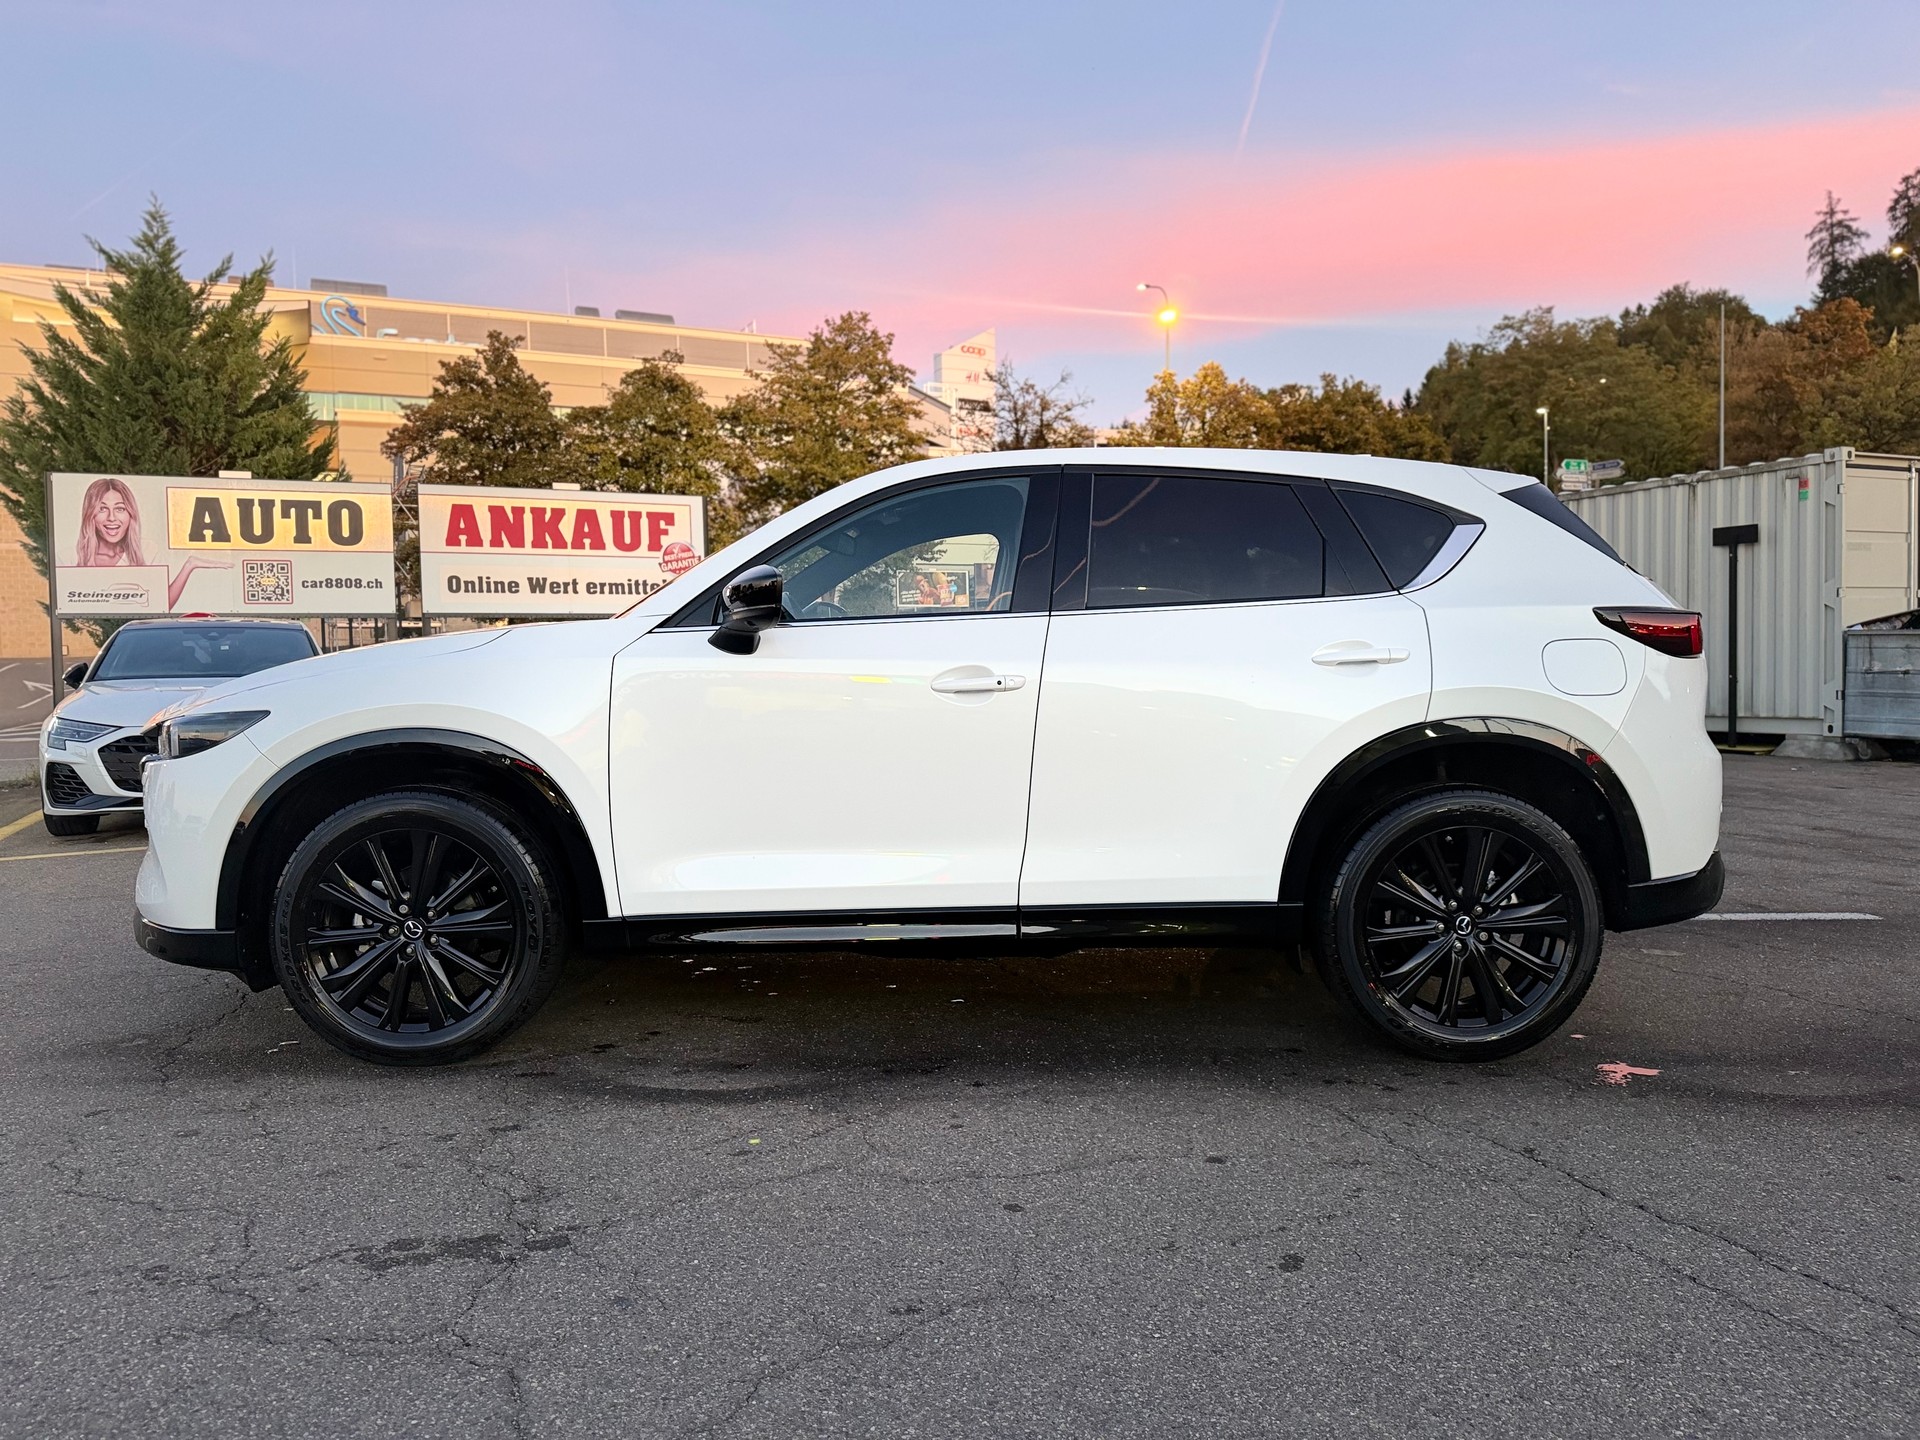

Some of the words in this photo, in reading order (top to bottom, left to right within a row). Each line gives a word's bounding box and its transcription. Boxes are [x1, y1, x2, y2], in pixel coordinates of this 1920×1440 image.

[188, 496, 364, 547] AUTO
[445, 503, 675, 553] ANKAUF
[301, 577, 384, 589] car8808.ch
[447, 575, 520, 594] Online
[527, 577, 579, 595] Wert
[585, 578, 668, 595] ermitte
[67, 590, 146, 600] Steinegger
